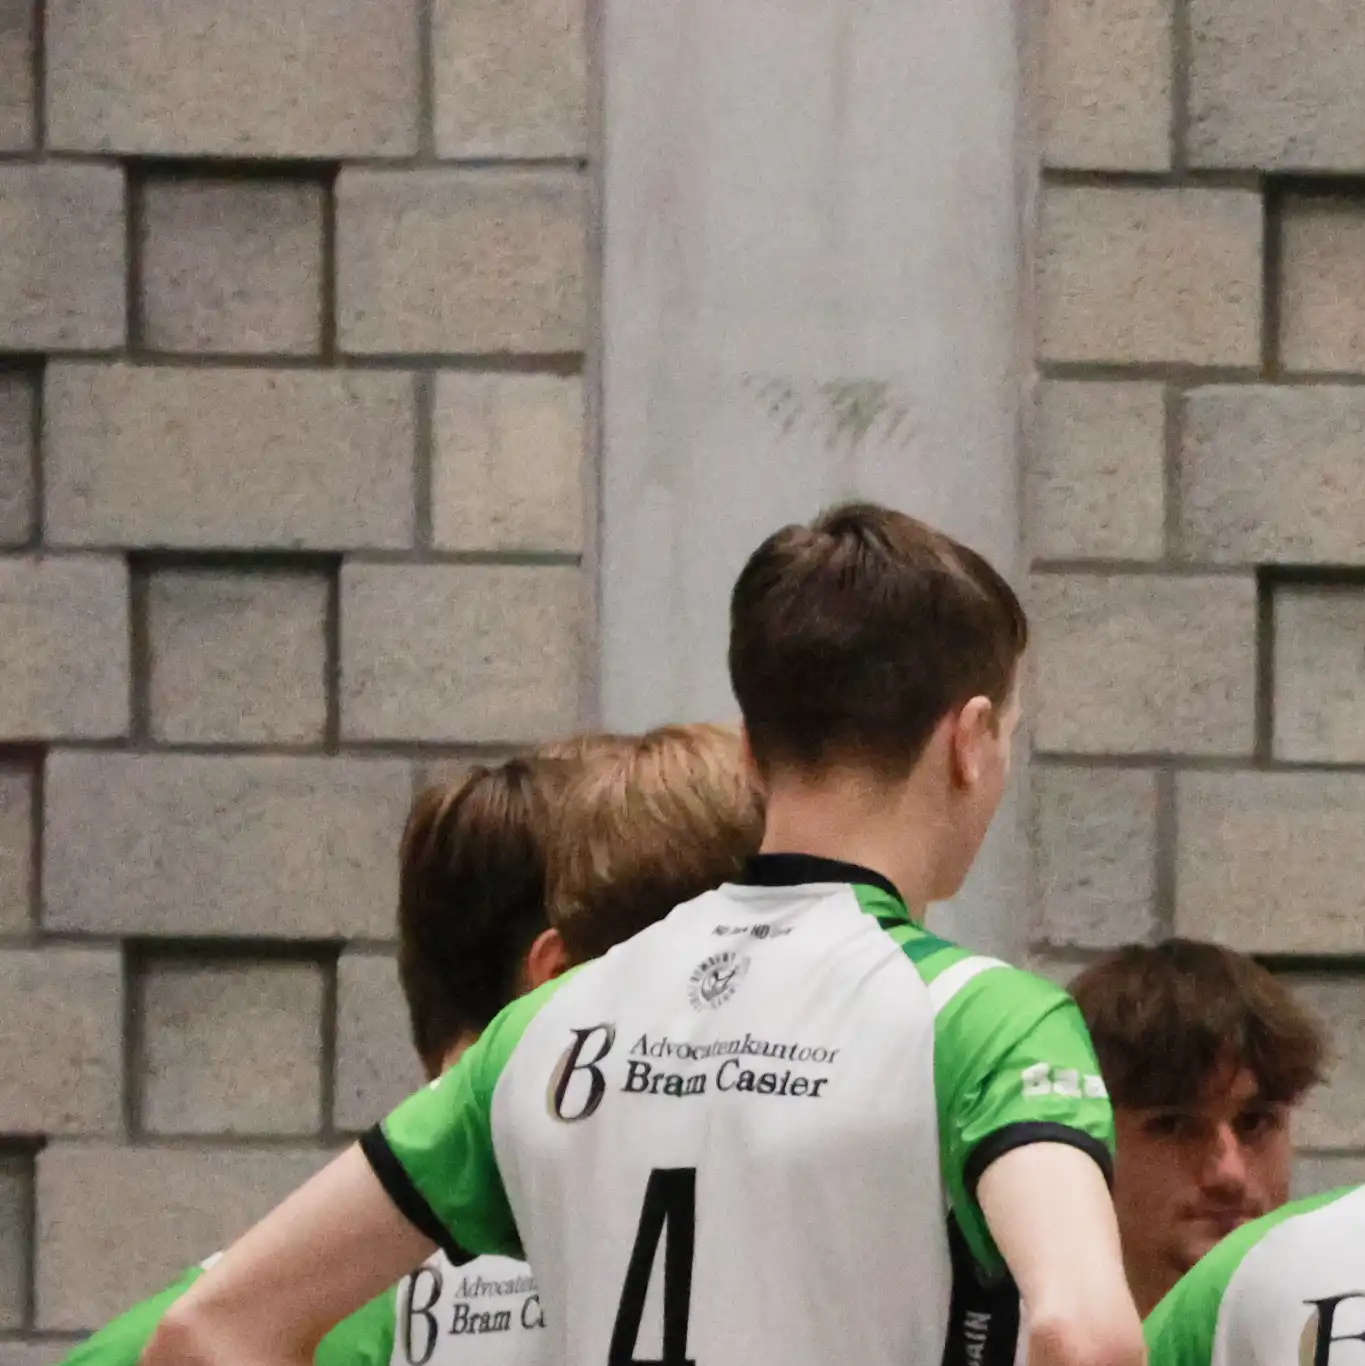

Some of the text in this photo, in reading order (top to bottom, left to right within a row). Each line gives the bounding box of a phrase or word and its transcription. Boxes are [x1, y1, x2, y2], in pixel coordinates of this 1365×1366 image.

[629, 1033, 840, 1064] Advocatenkantoor
[620, 1058, 829, 1098] Bram Casier
[448, 1303, 512, 1336] Bram
